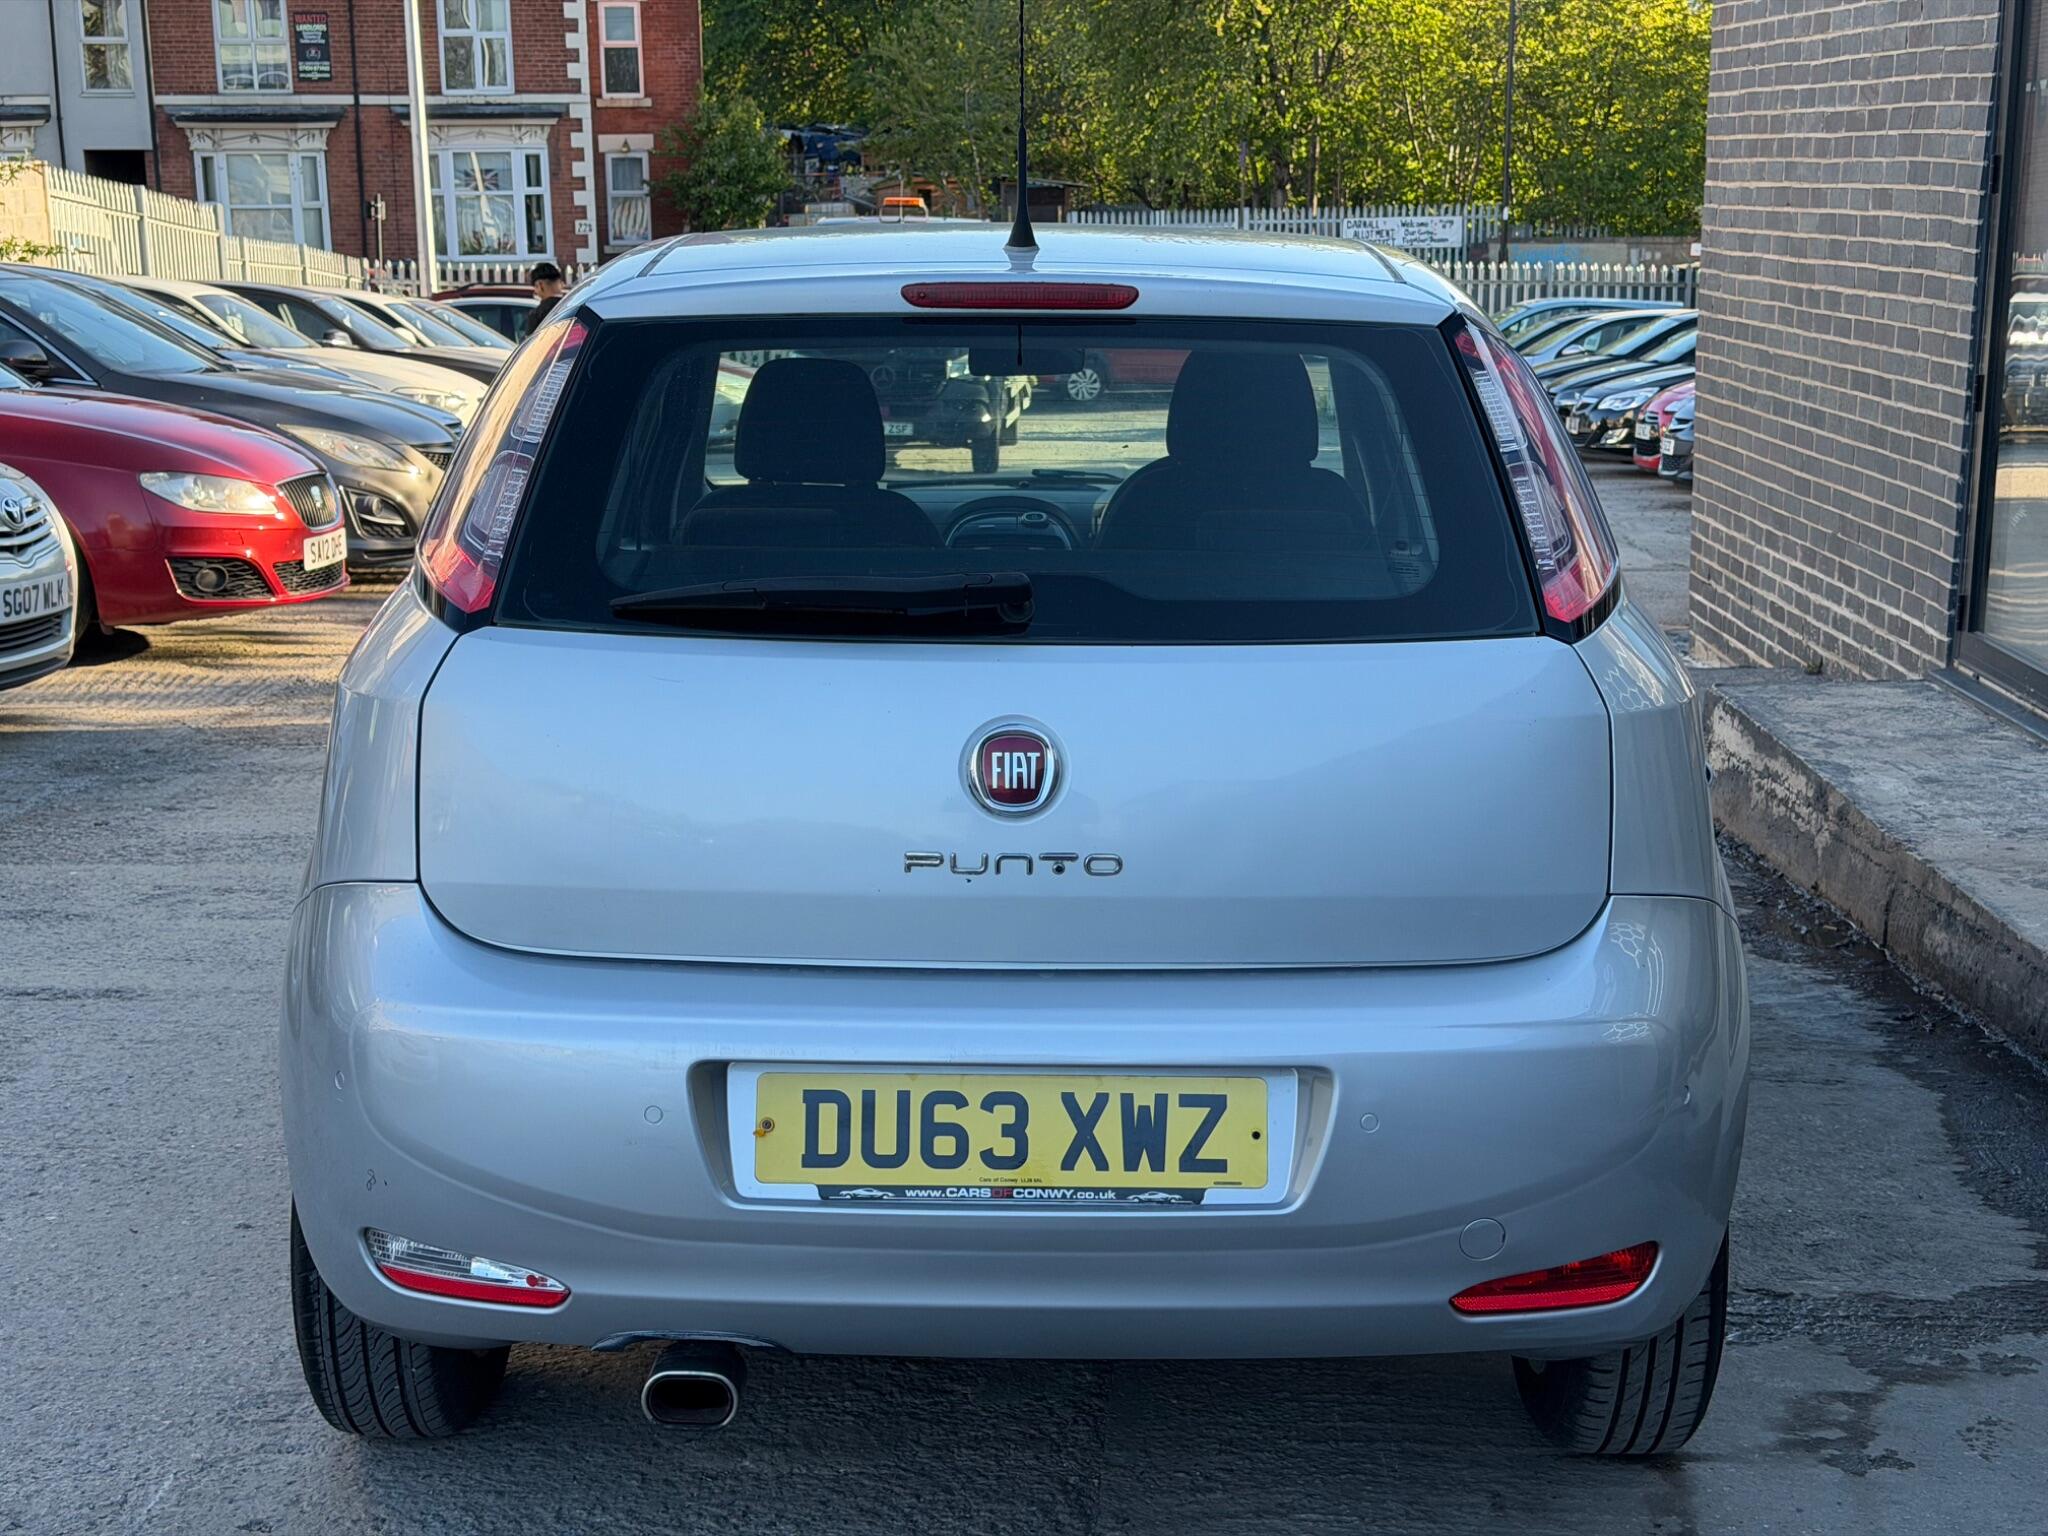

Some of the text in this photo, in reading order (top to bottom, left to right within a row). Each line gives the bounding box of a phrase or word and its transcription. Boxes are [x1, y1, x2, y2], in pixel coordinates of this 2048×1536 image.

[310, 538, 330, 564] SA12
[3, 578, 65, 618] SG07 WLK
[991, 752, 1041, 790] FIAT
[904, 852, 1124, 876] PUNTO
[801, 1089, 1228, 1173] DU63 XWZ
[905, 1187, 1116, 1200] www.CARSOFCONWY.co.uk
